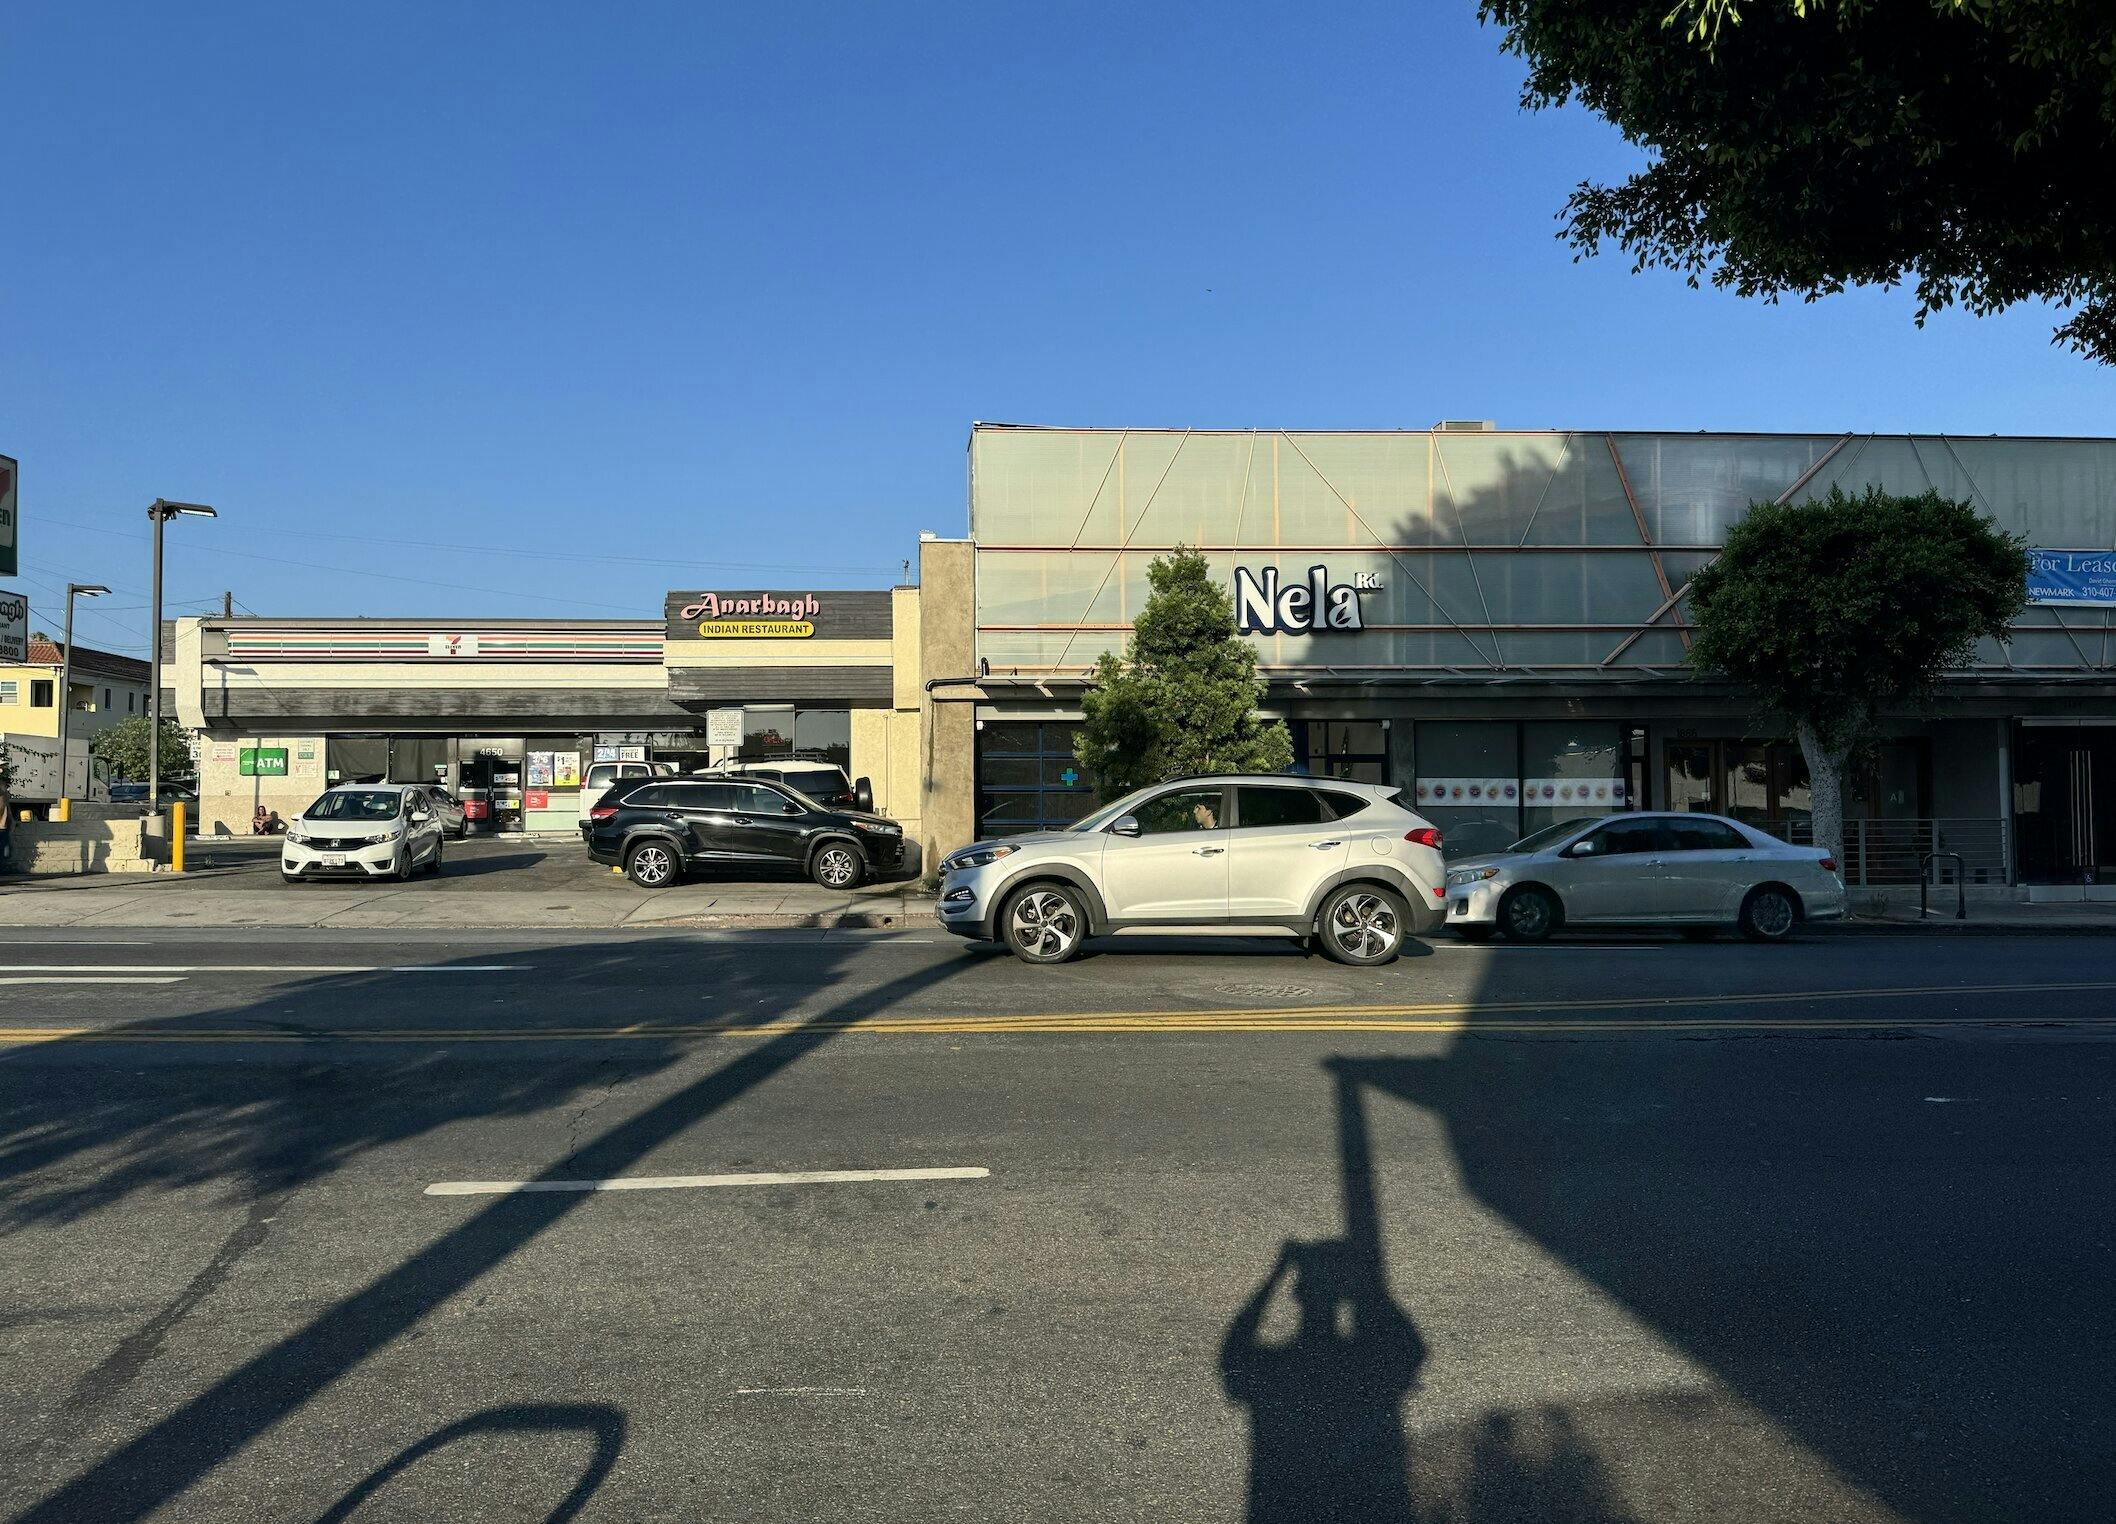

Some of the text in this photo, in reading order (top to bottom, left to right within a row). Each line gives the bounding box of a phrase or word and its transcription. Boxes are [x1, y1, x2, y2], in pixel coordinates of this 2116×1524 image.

[1355, 572, 1384, 588] Rd.
[2029, 588, 2074, 597] NEWMARK
[1236, 566, 1363, 632] Nela
[680, 592, 820, 621] Anarbagh
[703, 625, 809, 634] INDIAN RESTAURANT
[480, 748, 503, 756] 4650
[257, 757, 284, 768] ATM
